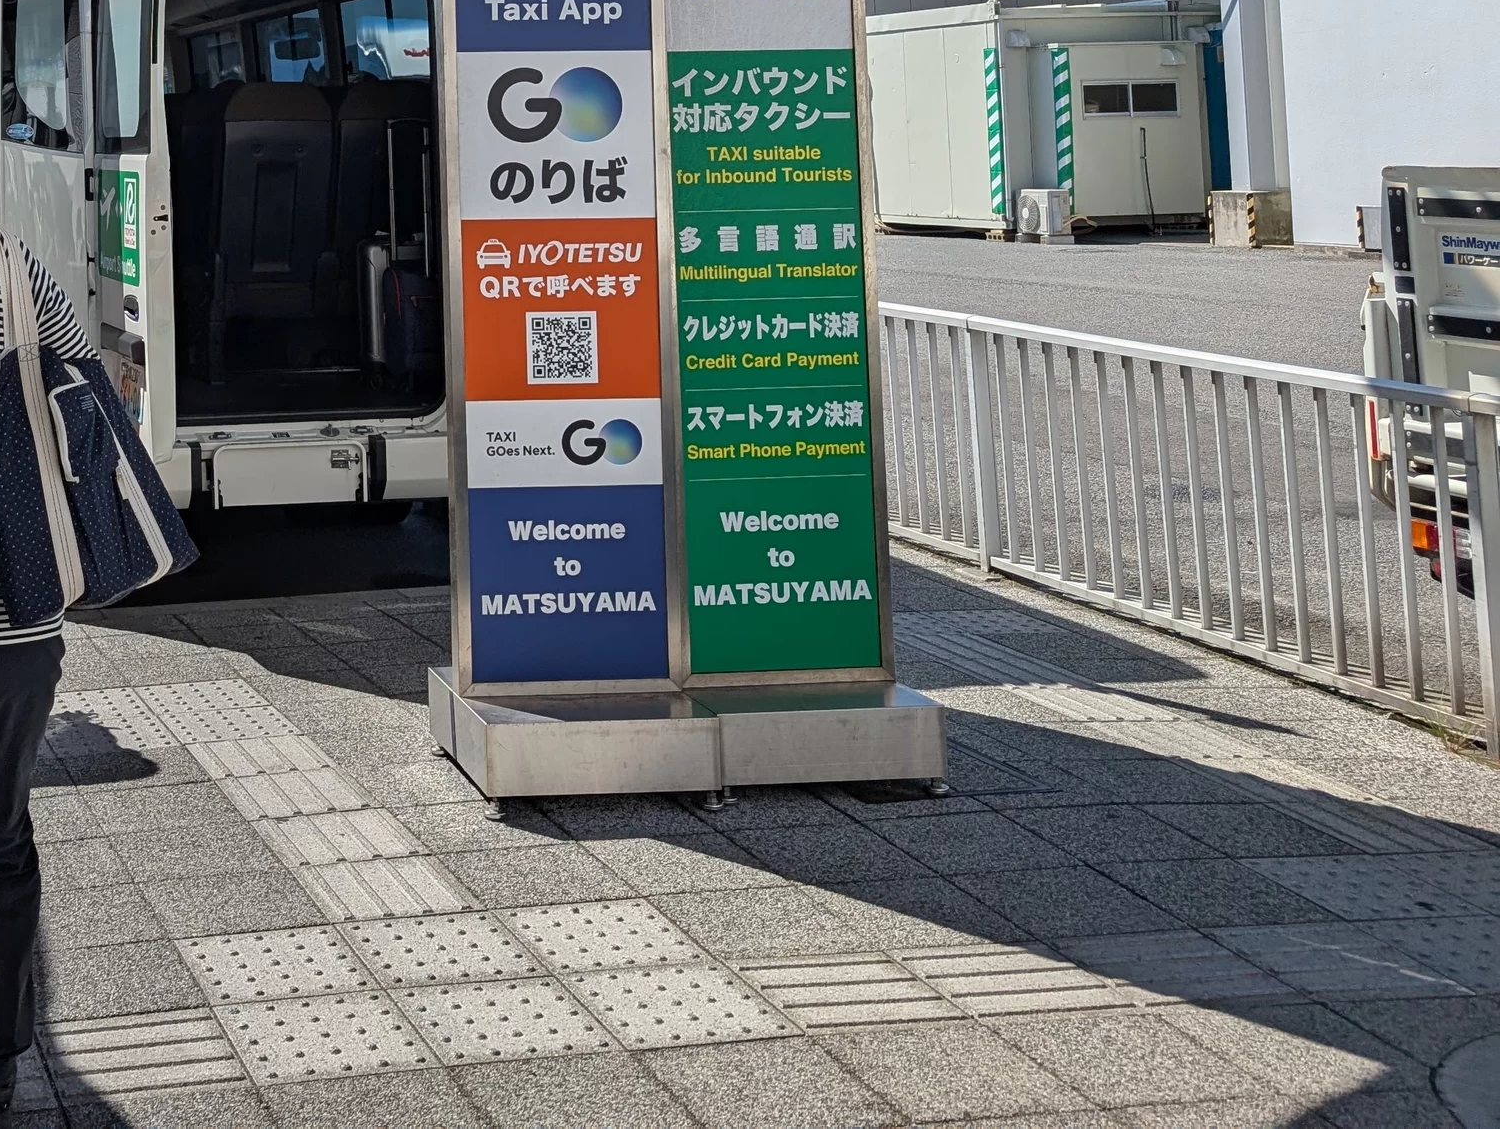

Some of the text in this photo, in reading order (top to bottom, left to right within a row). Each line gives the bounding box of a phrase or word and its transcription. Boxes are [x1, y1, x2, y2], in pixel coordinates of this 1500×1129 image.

[672, 67, 848, 96] インバウンド
[487, 66, 623, 143] GO
[673, 103, 850, 133] 対応タクシー
[707, 146, 821, 161] TAXI suitable
[490, 156, 627, 205] のりば
[676, 167, 852, 185] for Inbound Tourists
[679, 223, 856, 254] 多言語通訳
[518, 240, 643, 266] IYOTETSU
[680, 263, 857, 281] Multilingual Translator
[479, 275, 641, 299] QRで呼べます
[683, 312, 859, 343] クレジットカード決済
[686, 351, 859, 371] Credit Card Payment
[687, 401, 863, 431] スマートフォン決済
[486, 431, 516, 443] TAXI
[561, 419, 643, 465] GO
[486, 444, 555, 457] GOes Next.
[687, 440, 865, 460] Smart Phone Payment
[508, 519, 625, 541] Welcome
[720, 511, 839, 533] Welcome
[554, 556, 581, 577] to
[768, 547, 795, 567] to
[482, 592, 656, 615] MATSUYAMA
[694, 579, 872, 606] MATSUYAMA
